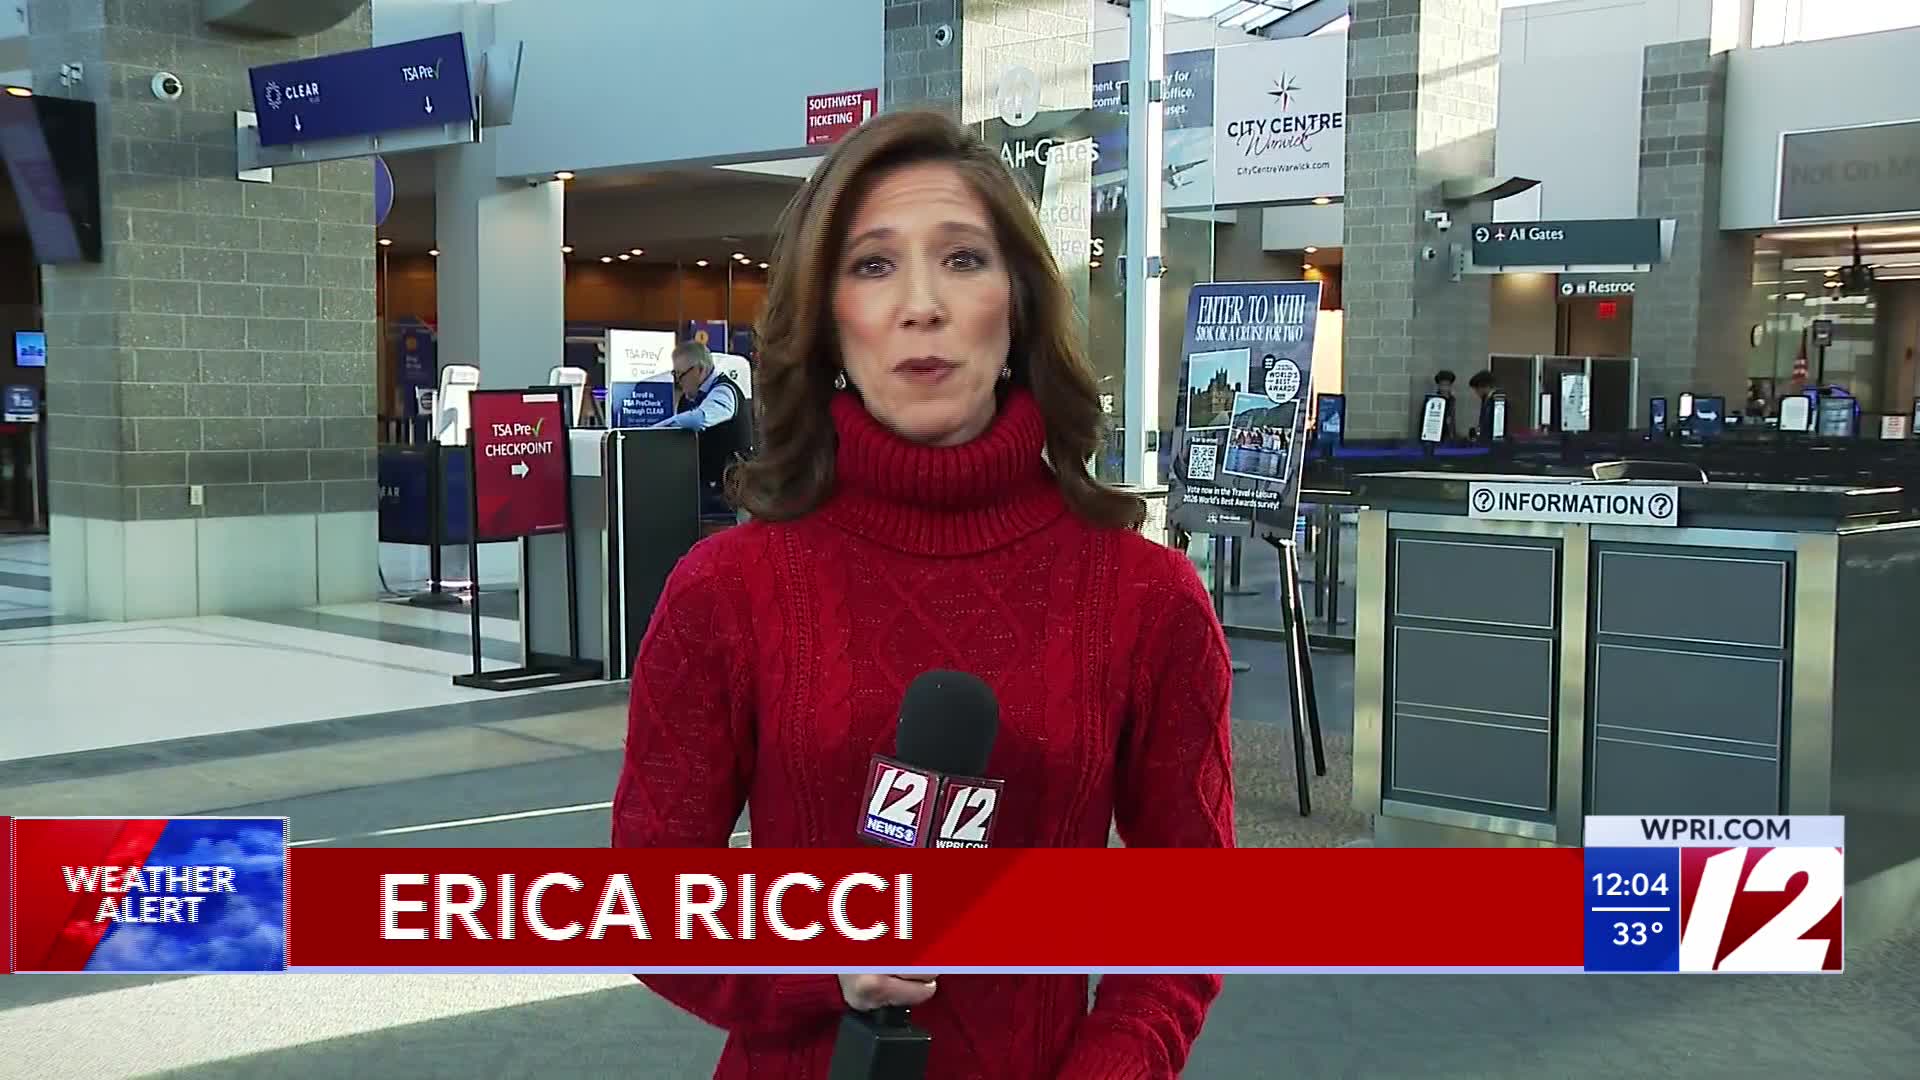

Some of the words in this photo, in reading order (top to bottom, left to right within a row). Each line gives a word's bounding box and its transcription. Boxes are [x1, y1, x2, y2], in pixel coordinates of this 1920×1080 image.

[402, 67, 419, 81] TSA
[1175, 70, 1190, 83] for
[285, 82, 319, 99] CLEAR
[808, 94, 862, 110] SOUTHWEST
[809, 112, 853, 127] TICKETING
[1227, 119, 1266, 137] CITY
[1270, 112, 1343, 133] CENTRE
[1000, 141, 1026, 168] All
[1034, 138, 1099, 166] Gates
[1237, 161, 1330, 175] CityCentreWarwick.com
[1509, 228, 1526, 240] All
[1528, 227, 1564, 241] Gates
[1198, 295, 1244, 325] ENTER
[1248, 295, 1268, 325] TO
[1273, 294, 1306, 325] WIN
[1265, 325, 1281, 341] FOR
[1283, 325, 1303, 341] TWO
[492, 424, 512, 437] TSA
[514, 423, 532, 436] Pre
[485, 441, 553, 457] CHECKPOINT
[1186, 485, 1200, 494] Vote
[1201, 487, 1213, 495] now
[1221, 487, 1231, 496] the
[1232, 488, 1249, 498] Travel
[1255, 490, 1278, 499] Leisure
[1221, 496, 1234, 506] Best
[1234, 497, 1256, 508] Awards
[1499, 492, 1644, 514] INFORMATION
[869, 768, 929, 826] 12
[940, 786, 997, 841] 12
[867, 817, 906, 840] NEWS
